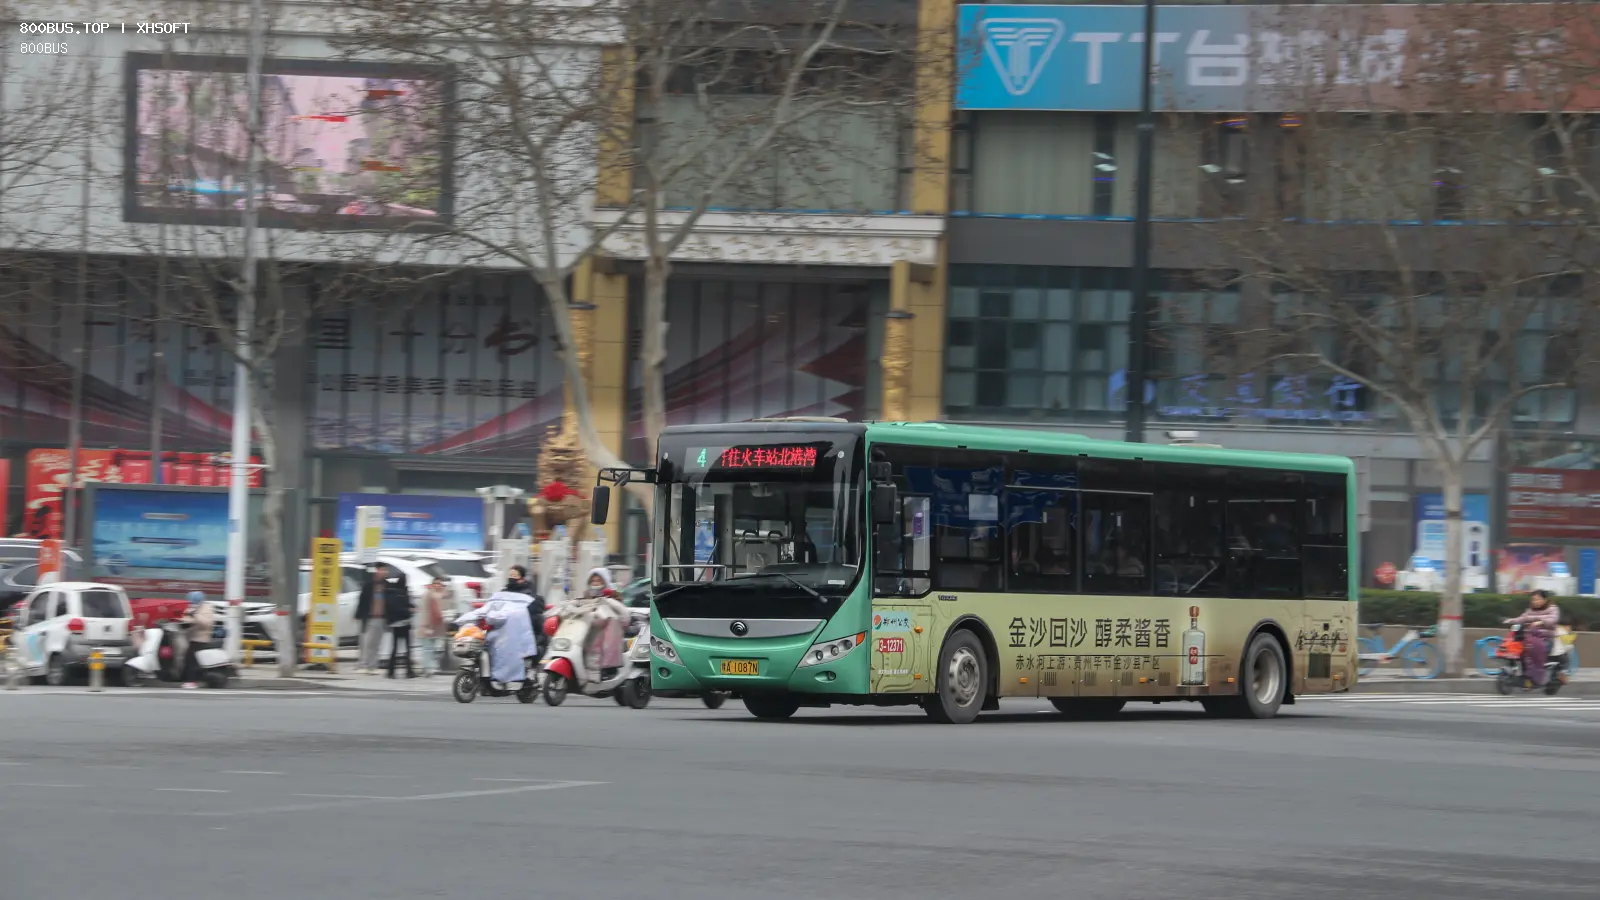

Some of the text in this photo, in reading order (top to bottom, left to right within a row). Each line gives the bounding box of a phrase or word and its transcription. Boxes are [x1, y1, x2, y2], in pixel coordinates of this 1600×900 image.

[697, 448, 707, 468] 4
[1008, 617, 1171, 649] 金沙回沙 醇柔酱香
[879, 639, 903, 652] 3-12371
[1015, 654, 1161, 671] 赤水河上游：贵州毕节金沙县产区
